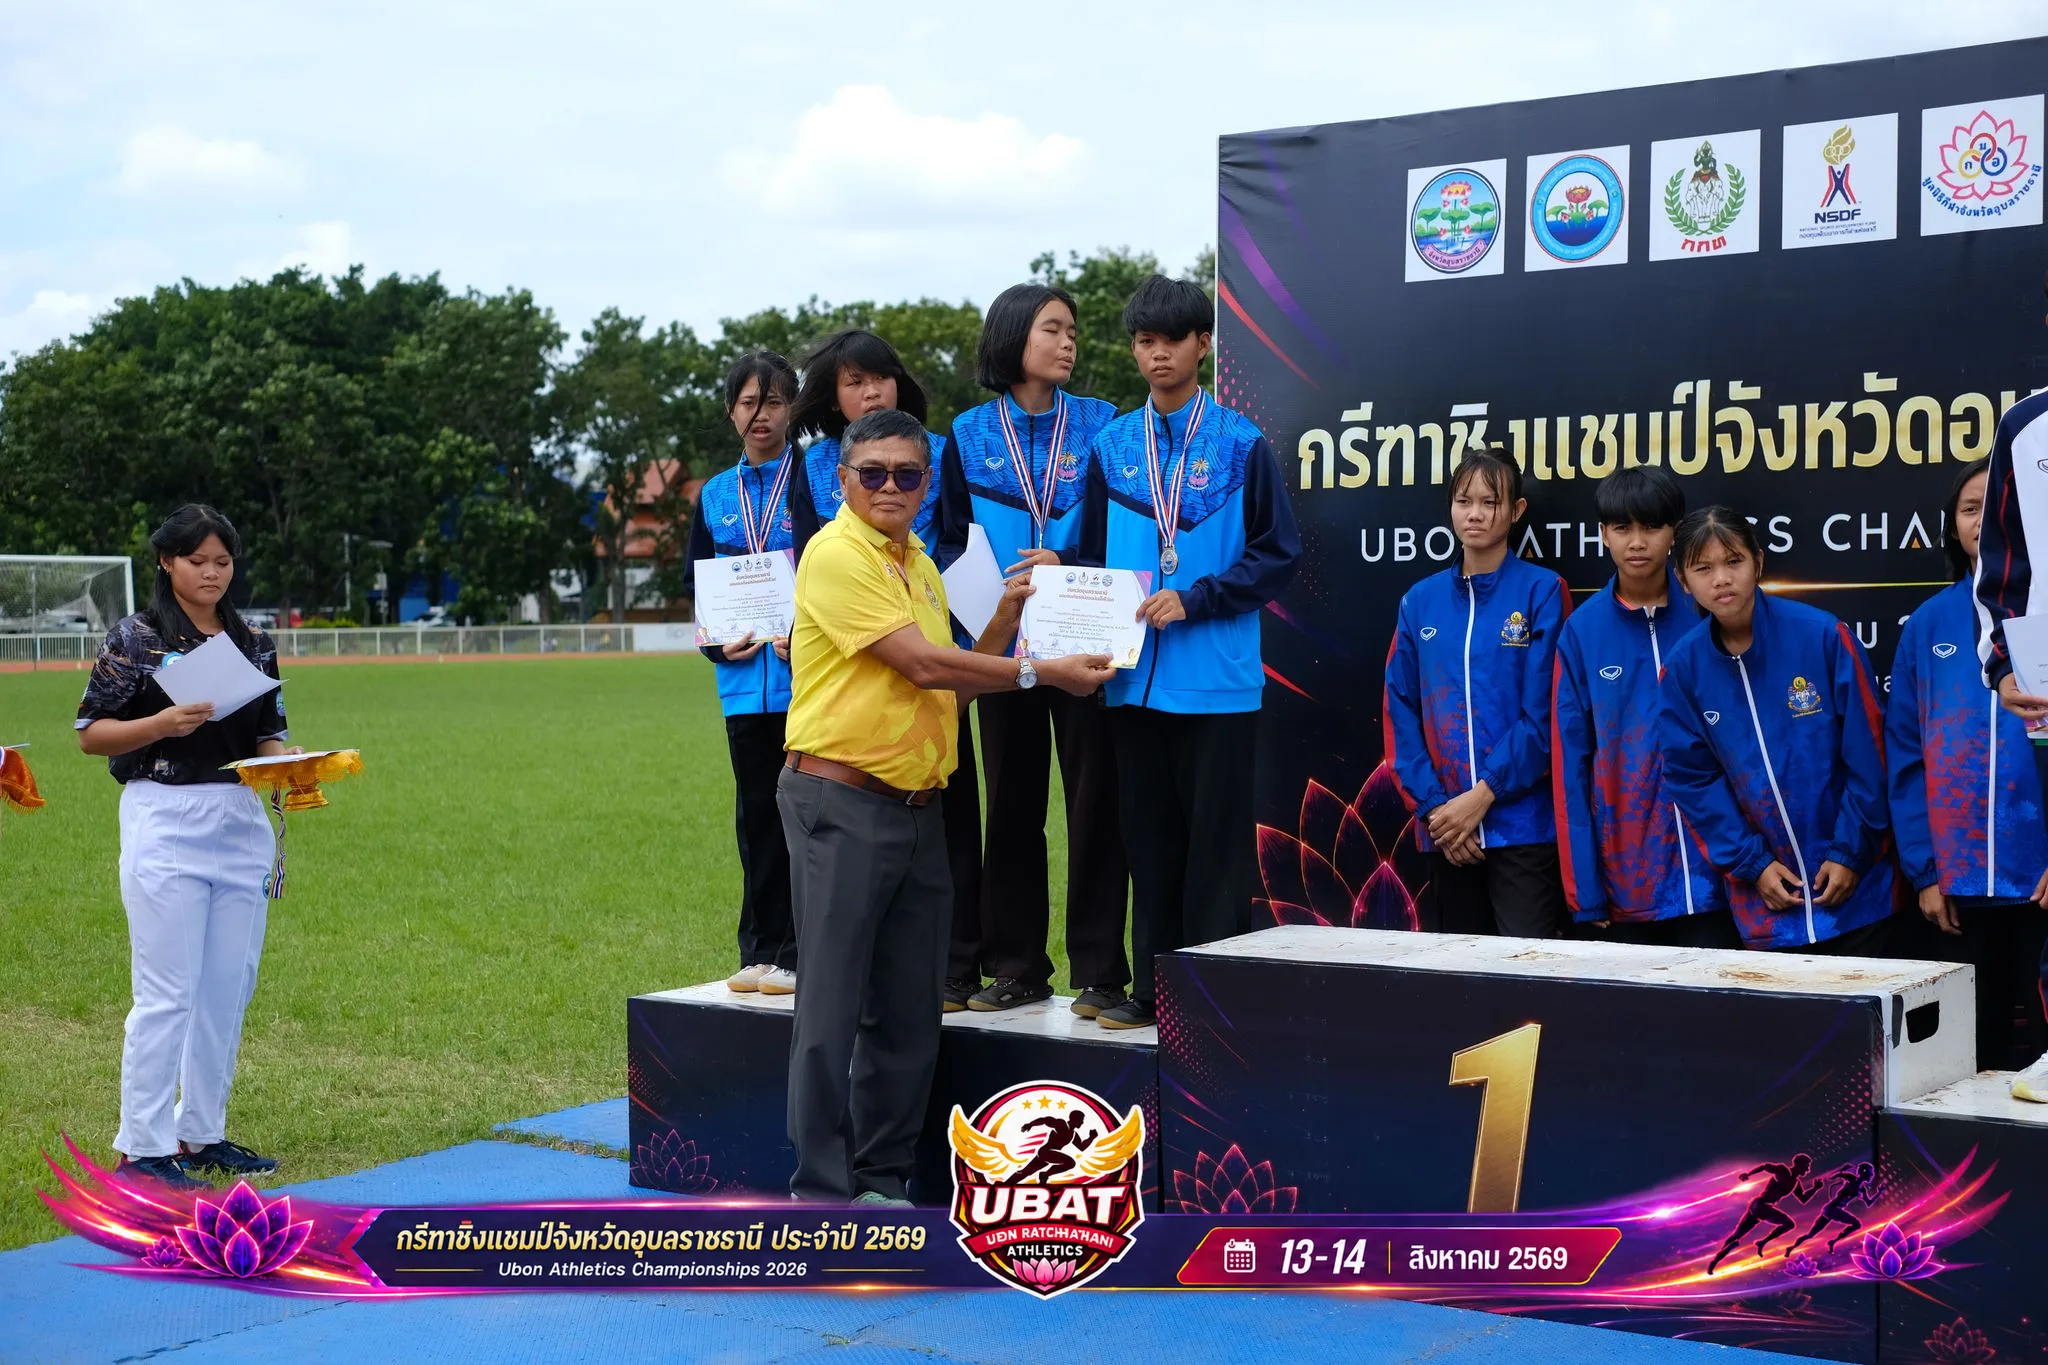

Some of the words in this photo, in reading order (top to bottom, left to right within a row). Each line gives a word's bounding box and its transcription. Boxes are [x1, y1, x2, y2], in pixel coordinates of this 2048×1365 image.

[1814, 208, 1862, 224] NSDF
[1361, 526, 1456, 562] UBO
[1449, 1023, 1541, 1213] 1
